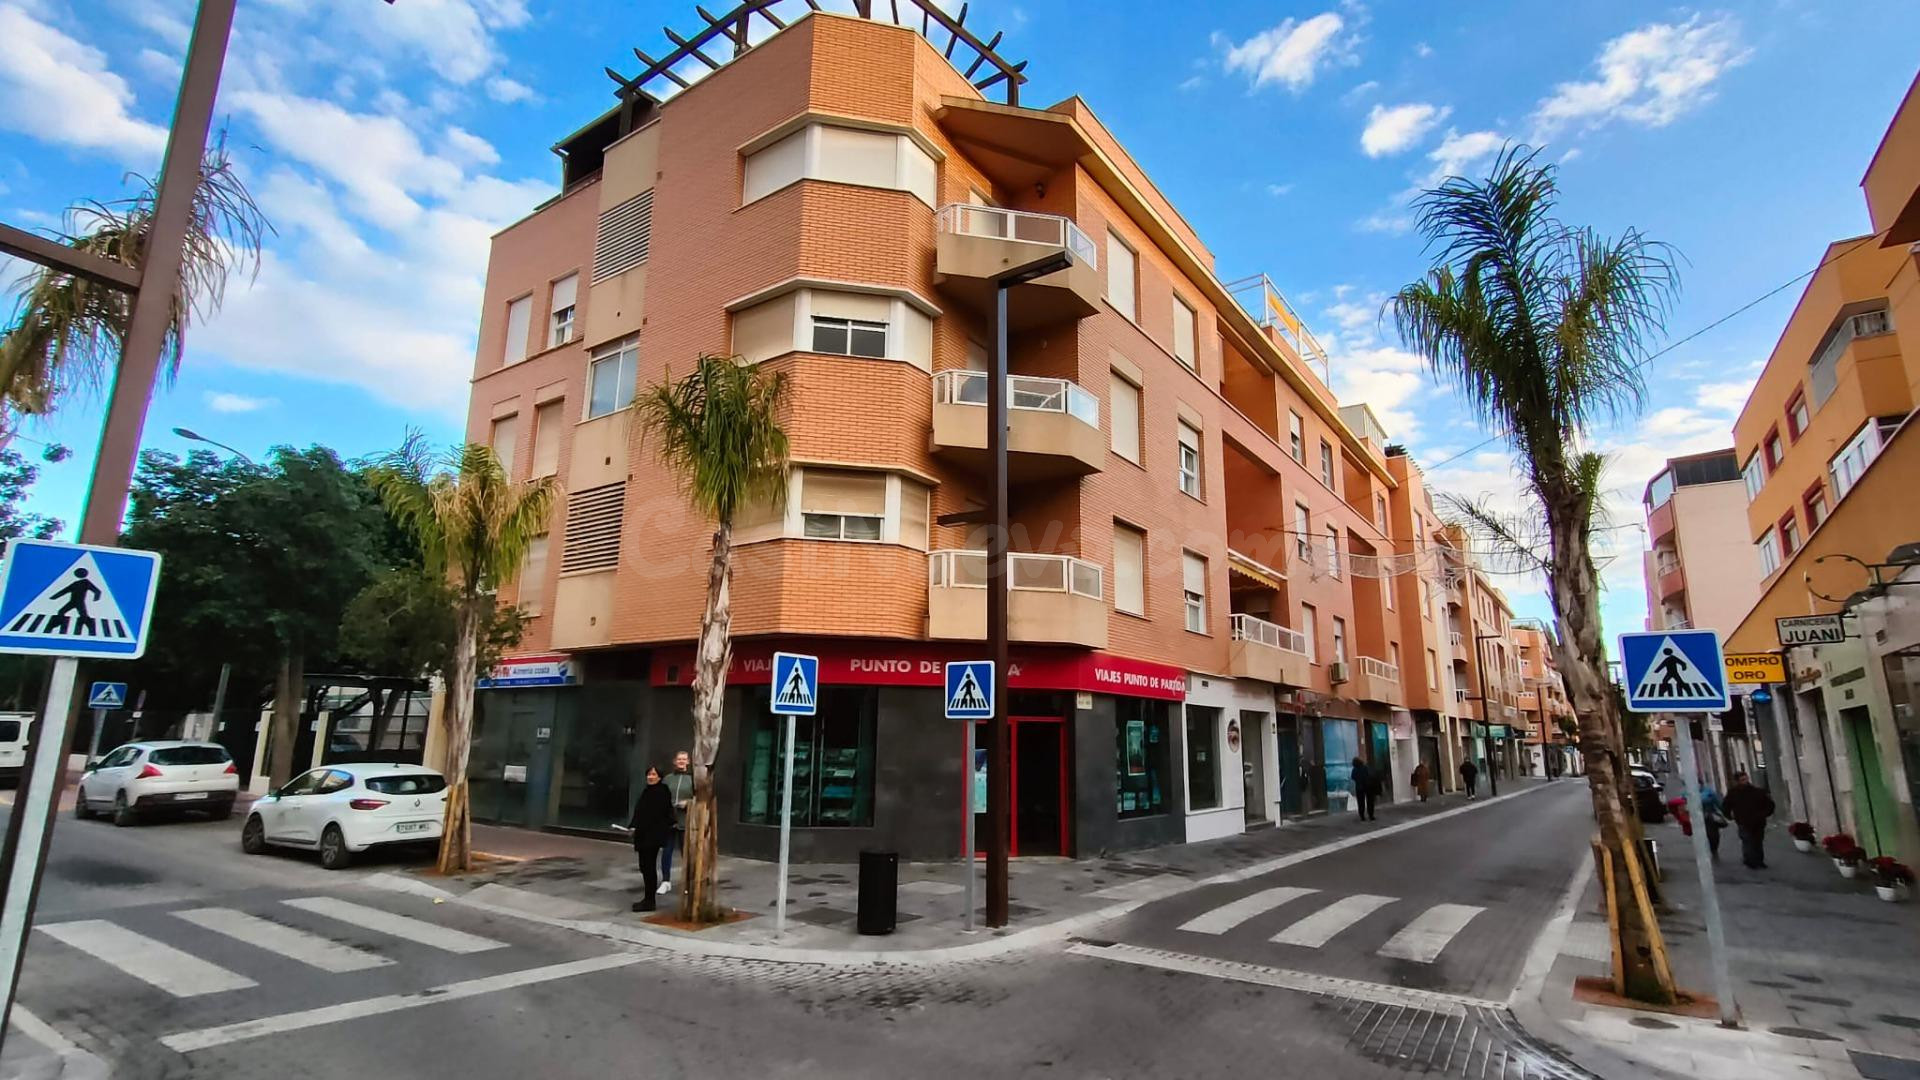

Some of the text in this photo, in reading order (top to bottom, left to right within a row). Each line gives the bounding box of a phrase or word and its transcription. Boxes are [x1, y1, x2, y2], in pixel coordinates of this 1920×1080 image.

[1785, 628, 1840, 642] JUANI
[743, 659, 772, 673] VIAJ
[850, 658, 942, 674] PUNTO DE
[1724, 657, 1779, 667] OMPRO
[1095, 668, 1185, 691] VIAJES PUNTO DE PARTIDA
[1733, 671, 1766, 680] ORO
